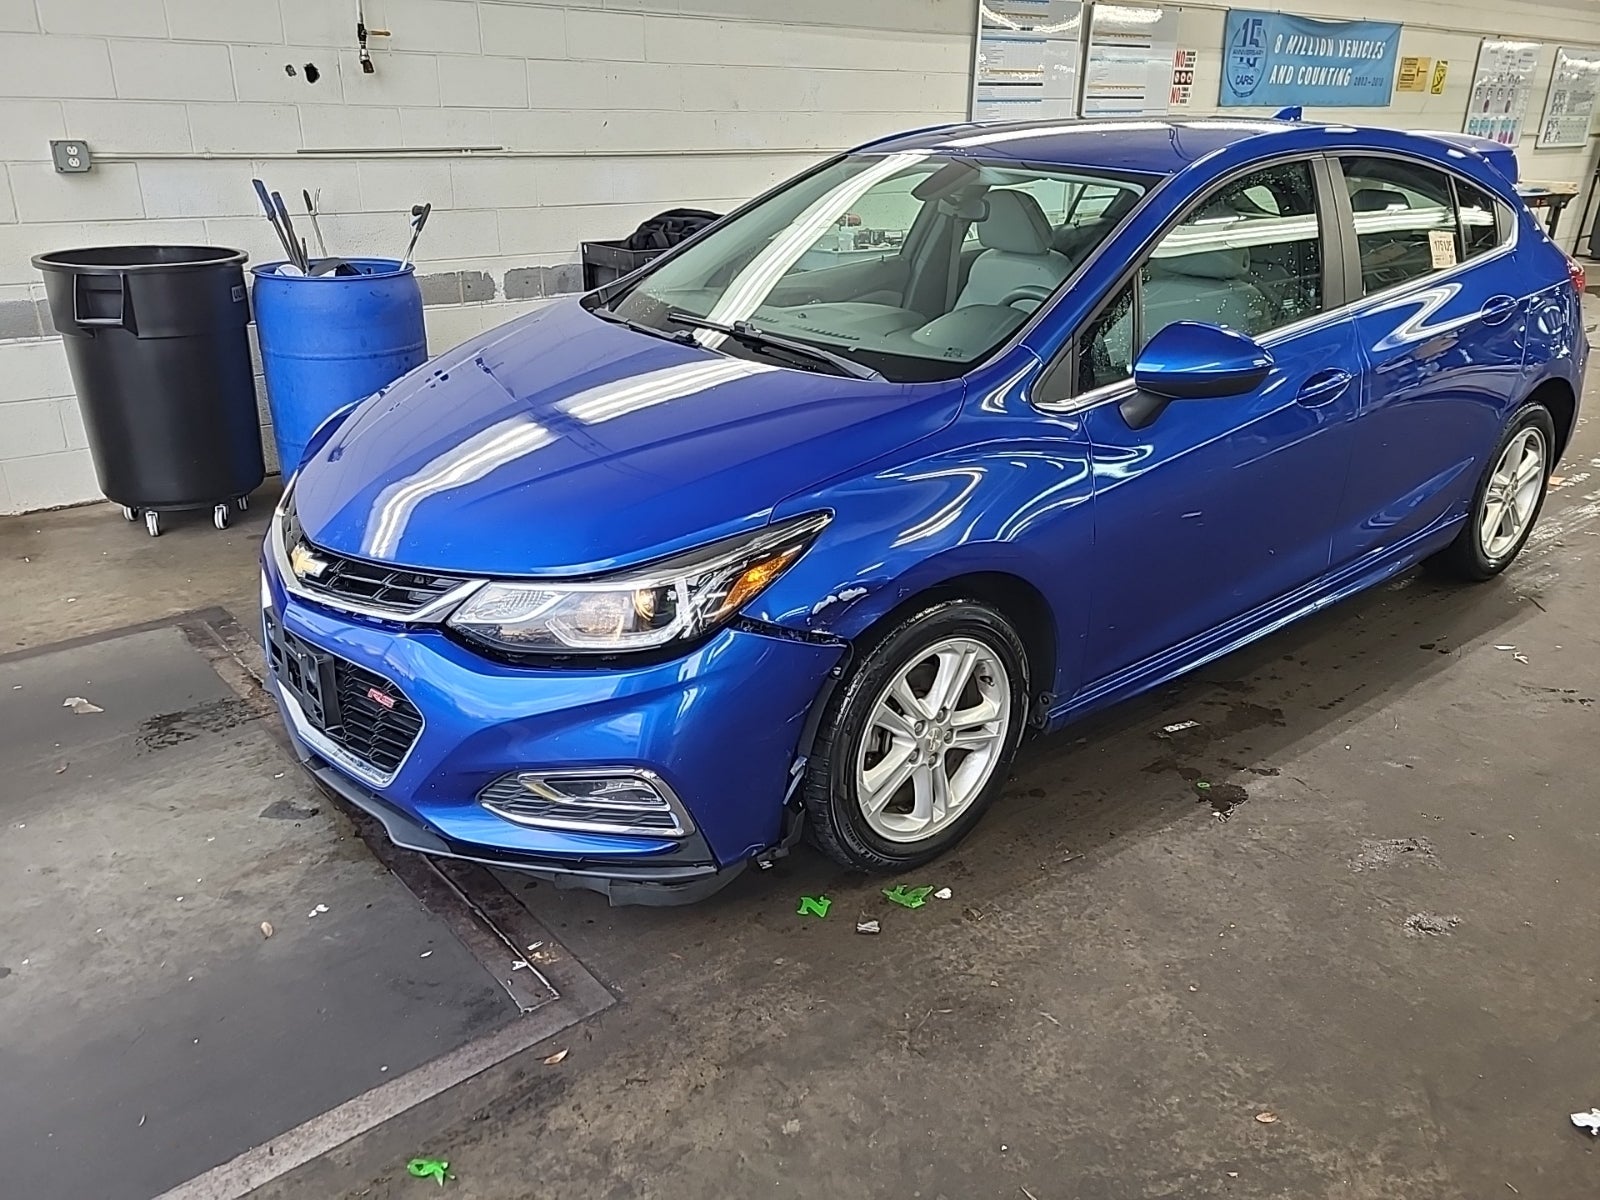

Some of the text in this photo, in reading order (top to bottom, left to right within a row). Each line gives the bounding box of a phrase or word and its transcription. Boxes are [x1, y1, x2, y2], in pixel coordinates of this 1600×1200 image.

[1274, 34, 1386, 59] 8 MILLION VEHICLES
[1175, 50, 1186, 68] NO
[1235, 75, 1254, 86] CARS
[1269, 64, 1294, 85] AND
[1297, 65, 1353, 86] COUNTING
[1170, 87, 1181, 104] NO
[367, 687, 394, 709] RS
